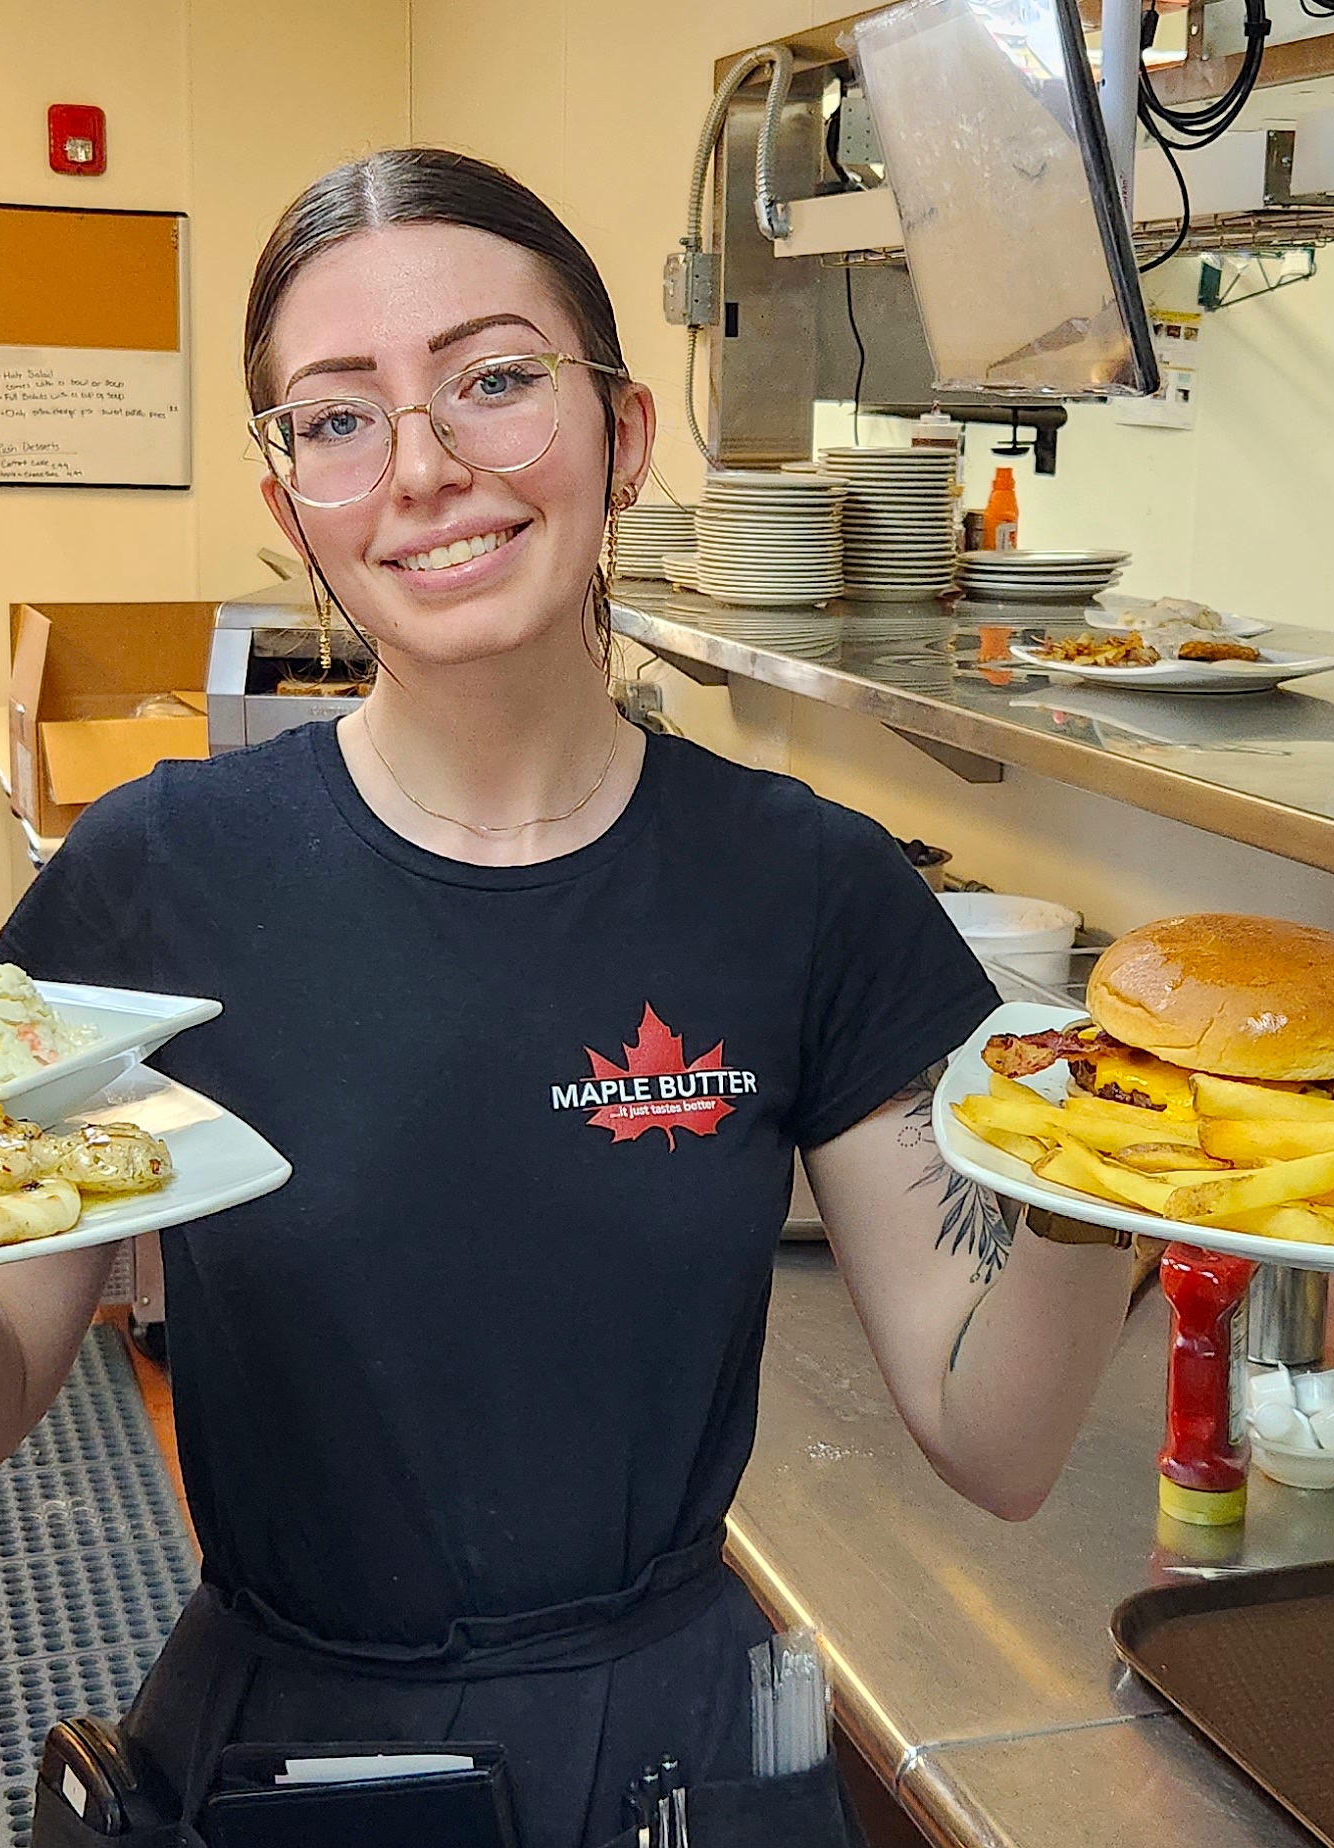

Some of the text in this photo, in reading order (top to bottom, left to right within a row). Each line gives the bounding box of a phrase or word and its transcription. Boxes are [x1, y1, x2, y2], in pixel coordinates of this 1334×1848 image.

[551, 1071, 757, 1110] MAPLE BUTTER
[630, 1104, 649, 1119] just
[650, 1102, 682, 1115] tastes
[683, 1100, 716, 1112] better
